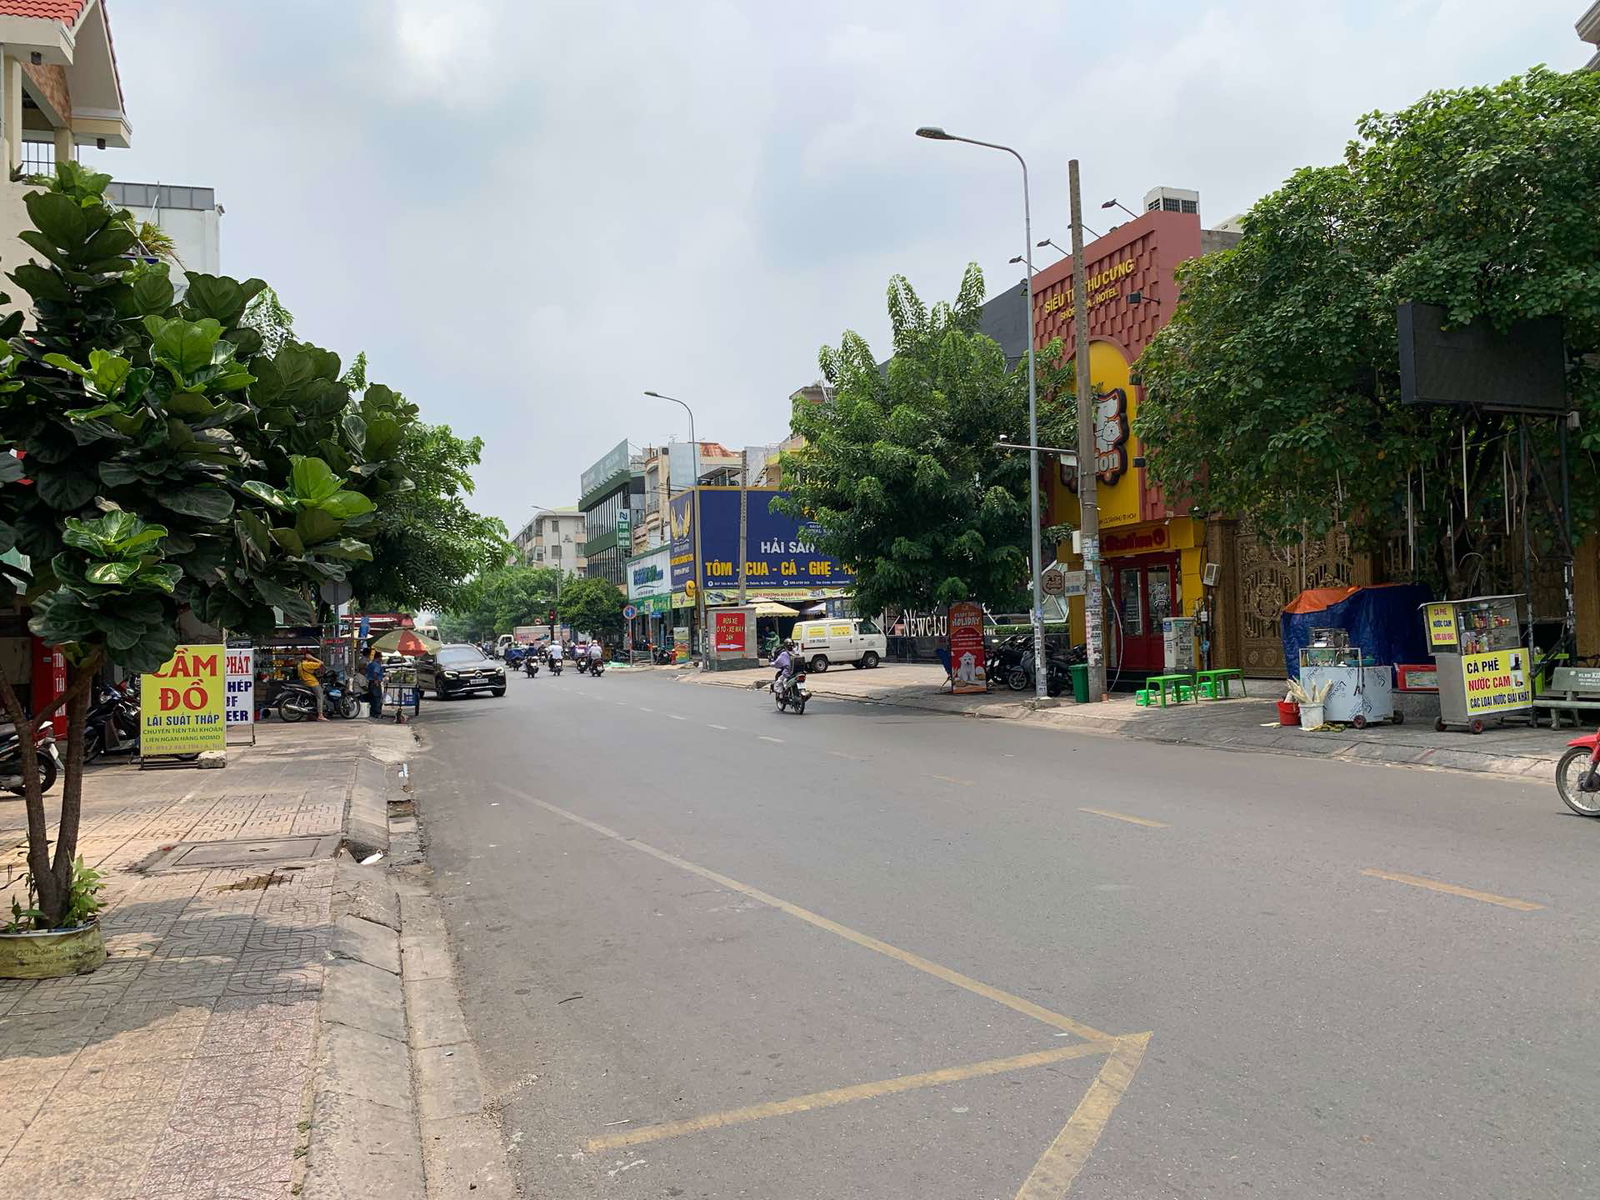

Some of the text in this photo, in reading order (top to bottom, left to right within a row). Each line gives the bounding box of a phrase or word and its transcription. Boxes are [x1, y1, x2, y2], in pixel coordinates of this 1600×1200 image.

[1102, 258, 1136, 285] CƯNG
[1096, 288, 1118, 303] HOTEL
[760, 537, 785, 554] HẢI
[705, 559, 733, 576] TÔM
[745, 561, 769, 576] CUA
[781, 559, 797, 576] CÁ
[808, 561, 831, 577] GHẸ
[152, 648, 218, 678] ẦM
[1466, 657, 1500, 674] CÀ PHÊ
[1468, 675, 1511, 692] NƯỚC CAM
[159, 679, 209, 711] ĐỒ
[166, 712, 191, 726] SUẤT
[195, 711, 220, 725] THẤP
